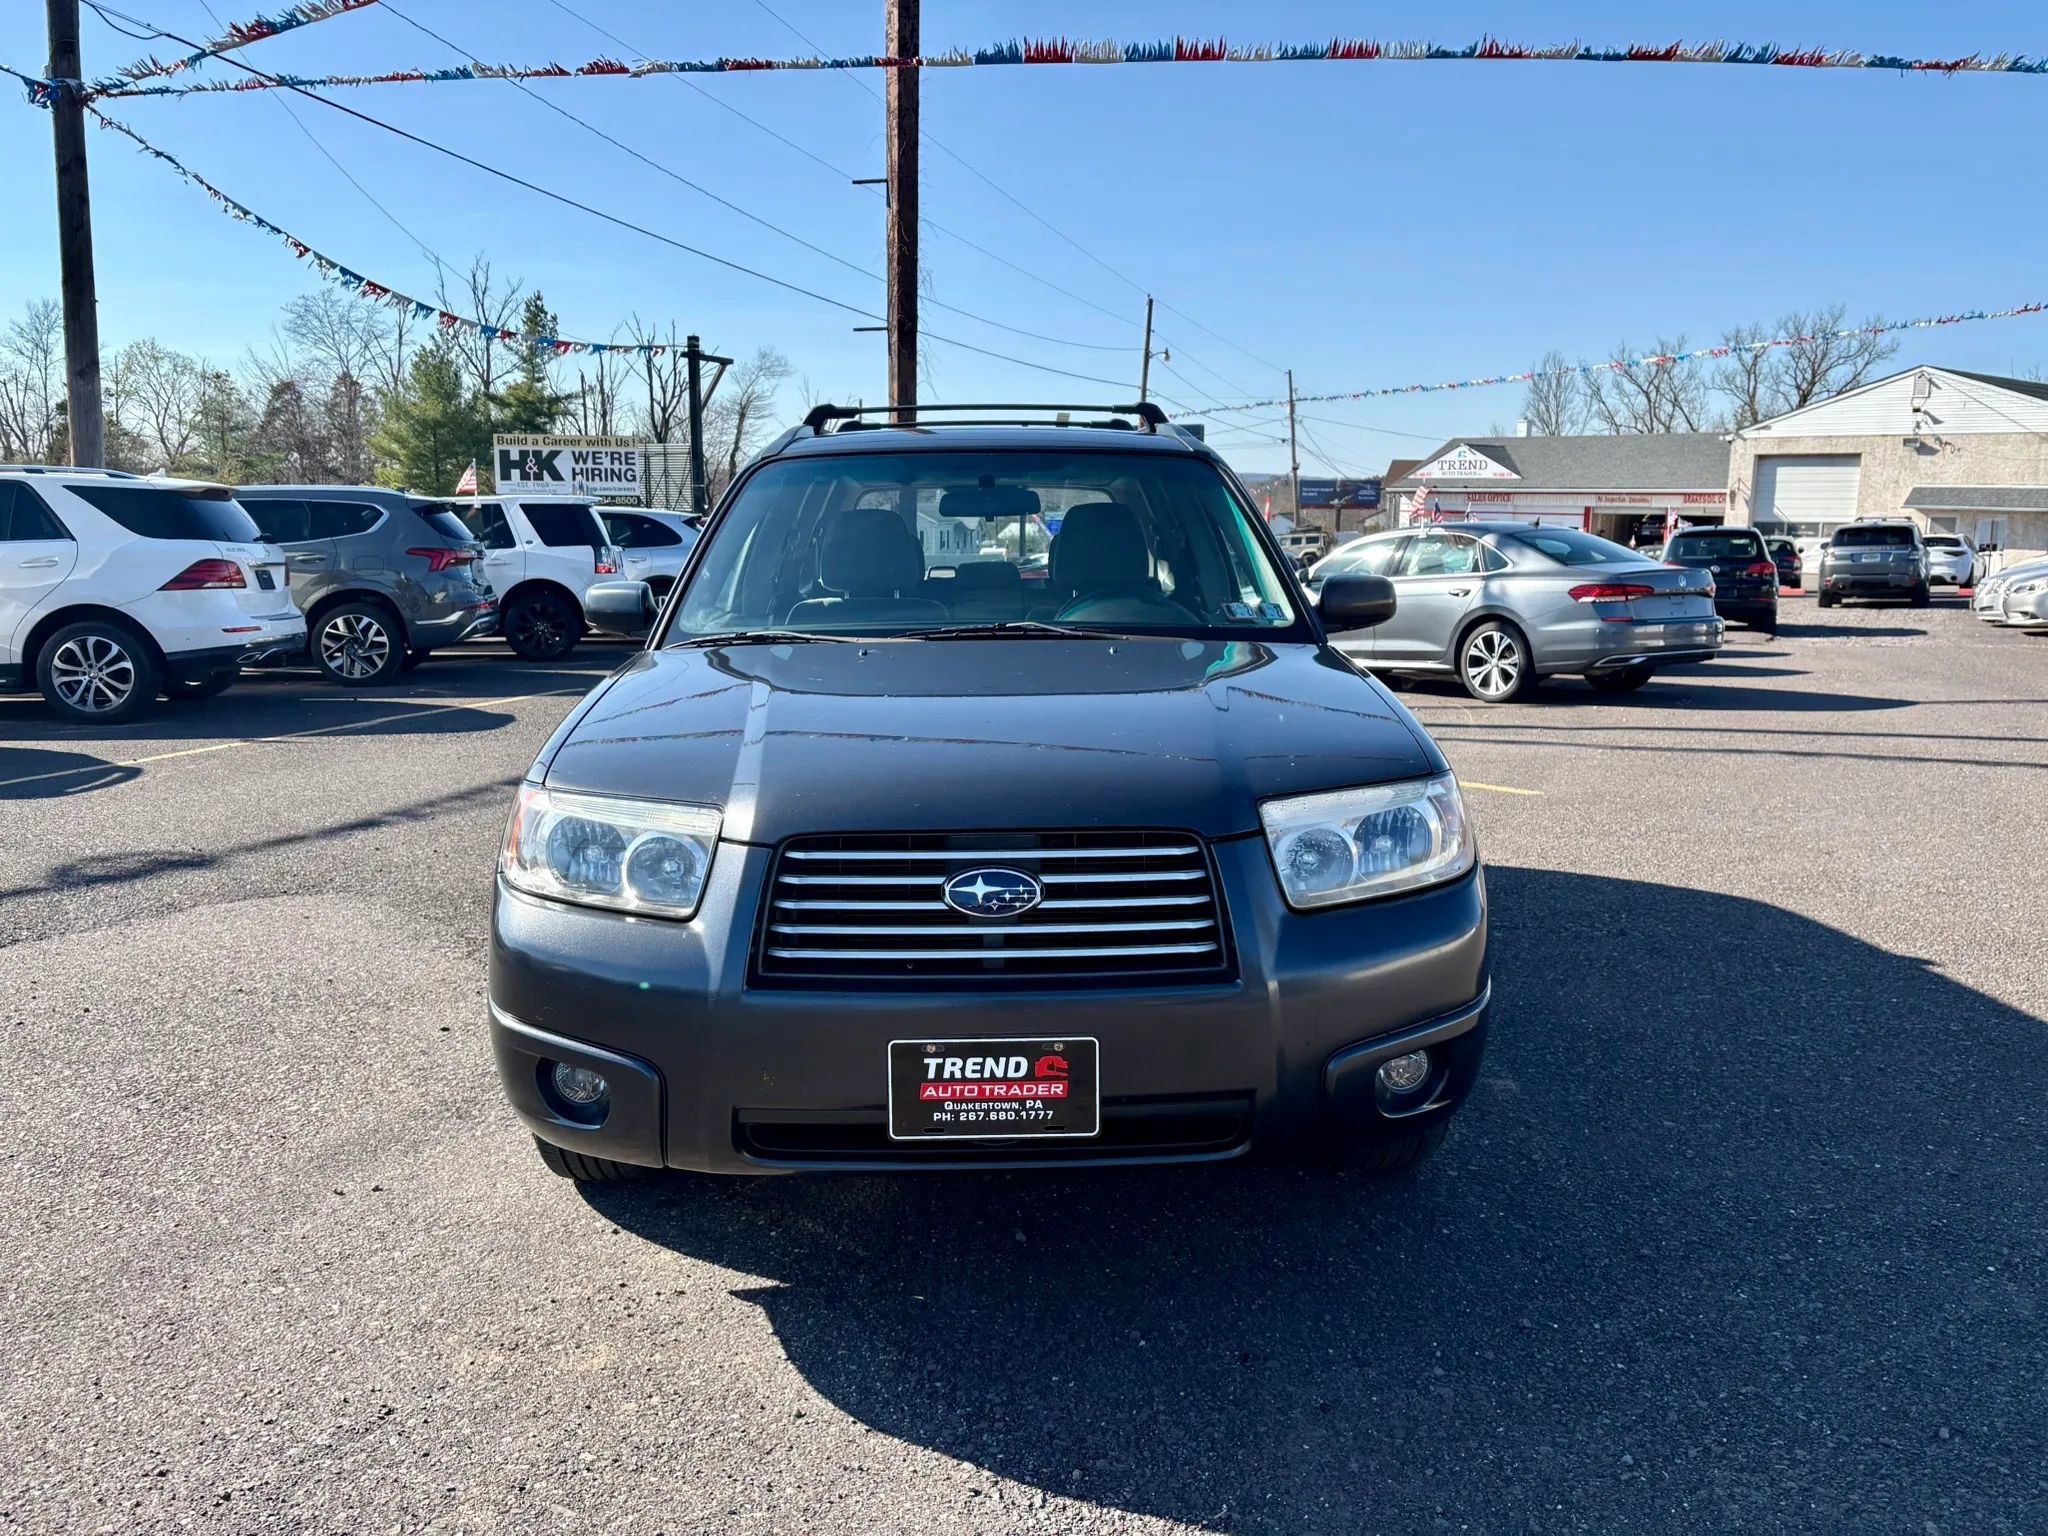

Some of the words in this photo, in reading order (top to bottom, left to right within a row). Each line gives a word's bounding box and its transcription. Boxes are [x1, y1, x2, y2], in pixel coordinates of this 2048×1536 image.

[497, 435, 528, 446] Build
[531, 438, 539, 446] a
[542, 436, 582, 447] Career
[585, 436, 612, 447] with
[498, 449, 566, 481] H&K
[1437, 460, 1488, 470] TREND
[571, 467, 637, 482] HIRING
[923, 1056, 1028, 1079] TREND
[1026, 1100, 1043, 1109] PA
[933, 1112, 955, 1121] PH:
[959, 1110, 1054, 1121] 267.680.1777
